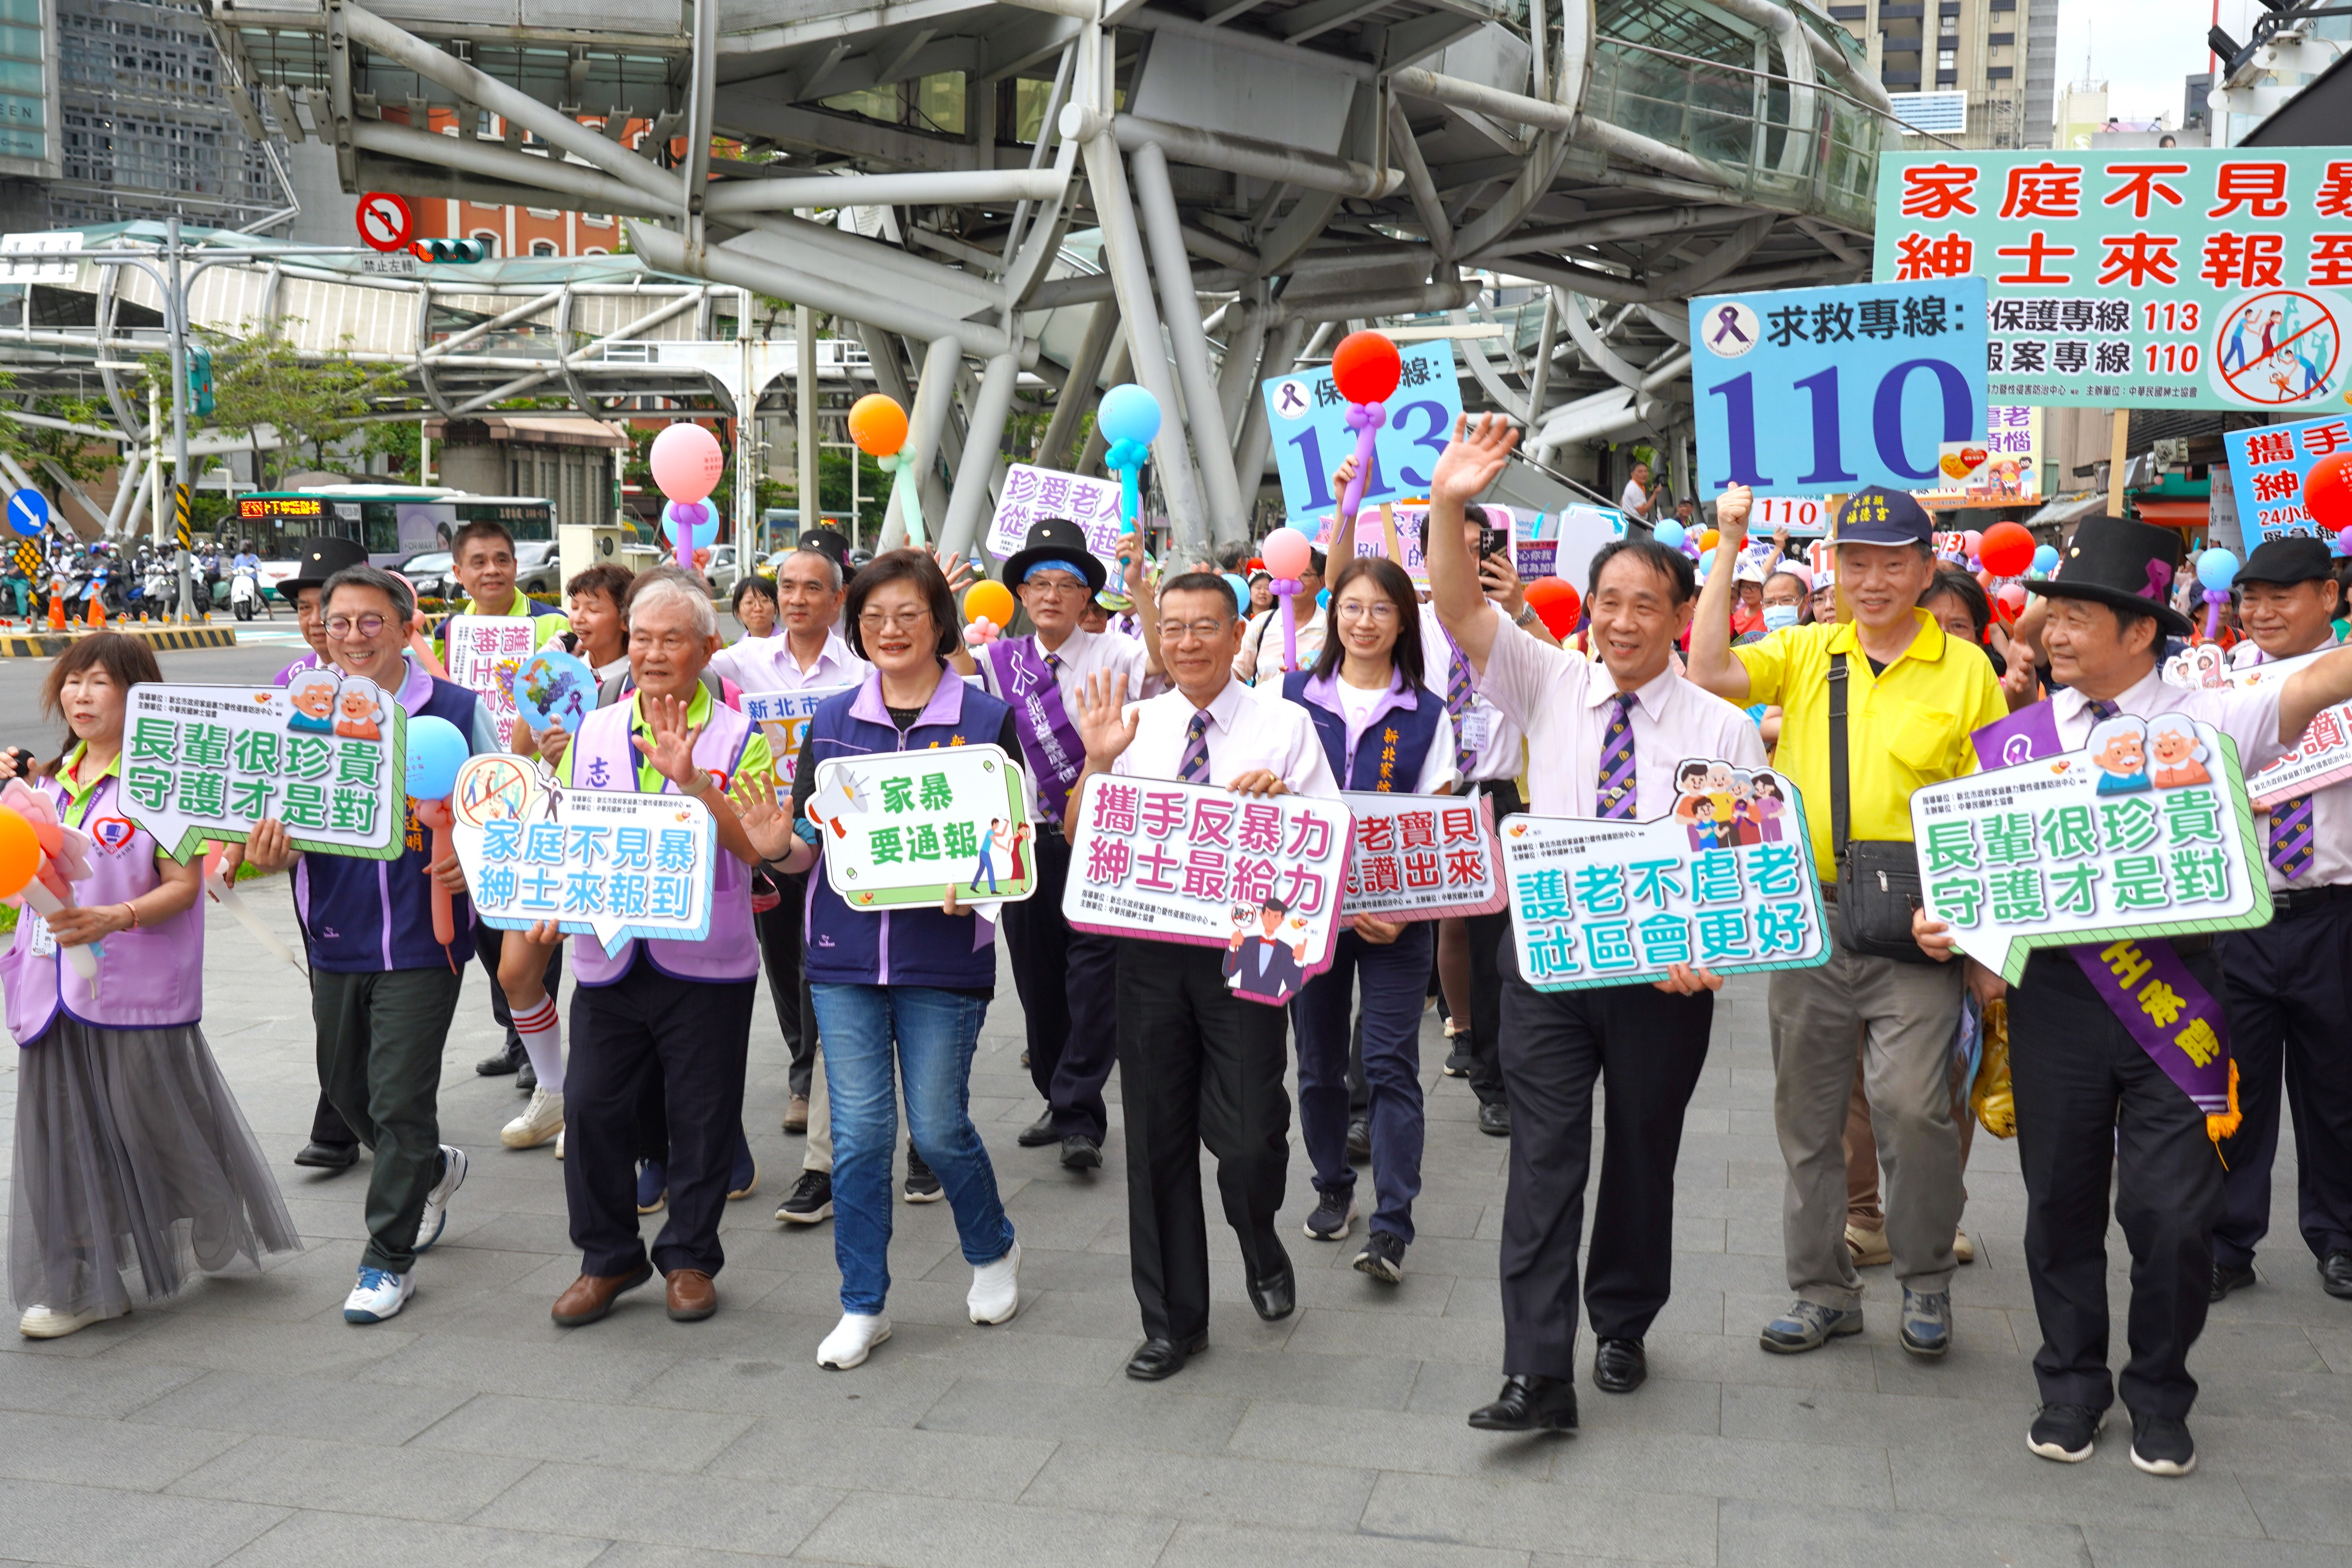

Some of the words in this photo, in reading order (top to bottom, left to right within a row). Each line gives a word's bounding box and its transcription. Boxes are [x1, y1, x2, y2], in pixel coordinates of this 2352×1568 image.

[1, 138, 34, 150] Cinema
[364, 259, 414, 273] 禁止左轉
[1766, 295, 1965, 347] 求救專線：
[1991, 299, 2130, 332] 保護專線
[2145, 303, 2198, 330] 113
[1314, 356, 1442, 408] 保線：
[2145, 345, 2198, 372] 110
[1708, 358, 1973, 489] 110
[2246, 421, 2350, 465] 攜手
[1006, 470, 1122, 524] 珍愛老人
[2252, 469, 2299, 502] 紳
[999, 503, 1120, 557] 從起
[1762, 499, 1817, 525] 110
[748, 695, 819, 719] 新北市
[130, 717, 383, 787] 長輩很珍貴
[586, 757, 610, 787] 志
[2246, 751, 2352, 793] ：新北市政府家庭暴力暨性侵害防治中心
[129, 765, 378, 833] 守護才是對
[880, 772, 953, 814] 家暴
[482, 819, 695, 871] 家庭不見暴
[868, 820, 979, 866] 要通報
[1093, 782, 1330, 858] 攜手反暴力
[1357, 806, 1479, 852] 老寶貝
[1924, 789, 2220, 873] 長輩很珍貴
[476, 866, 691, 918] 紳士來報到
[1086, 835, 1323, 913] 紳士最給力
[1516, 843, 1799, 923] 護老不虐老
[1932, 847, 2228, 926] 守護才是對
[1526, 902, 1807, 977] 社區會更好
